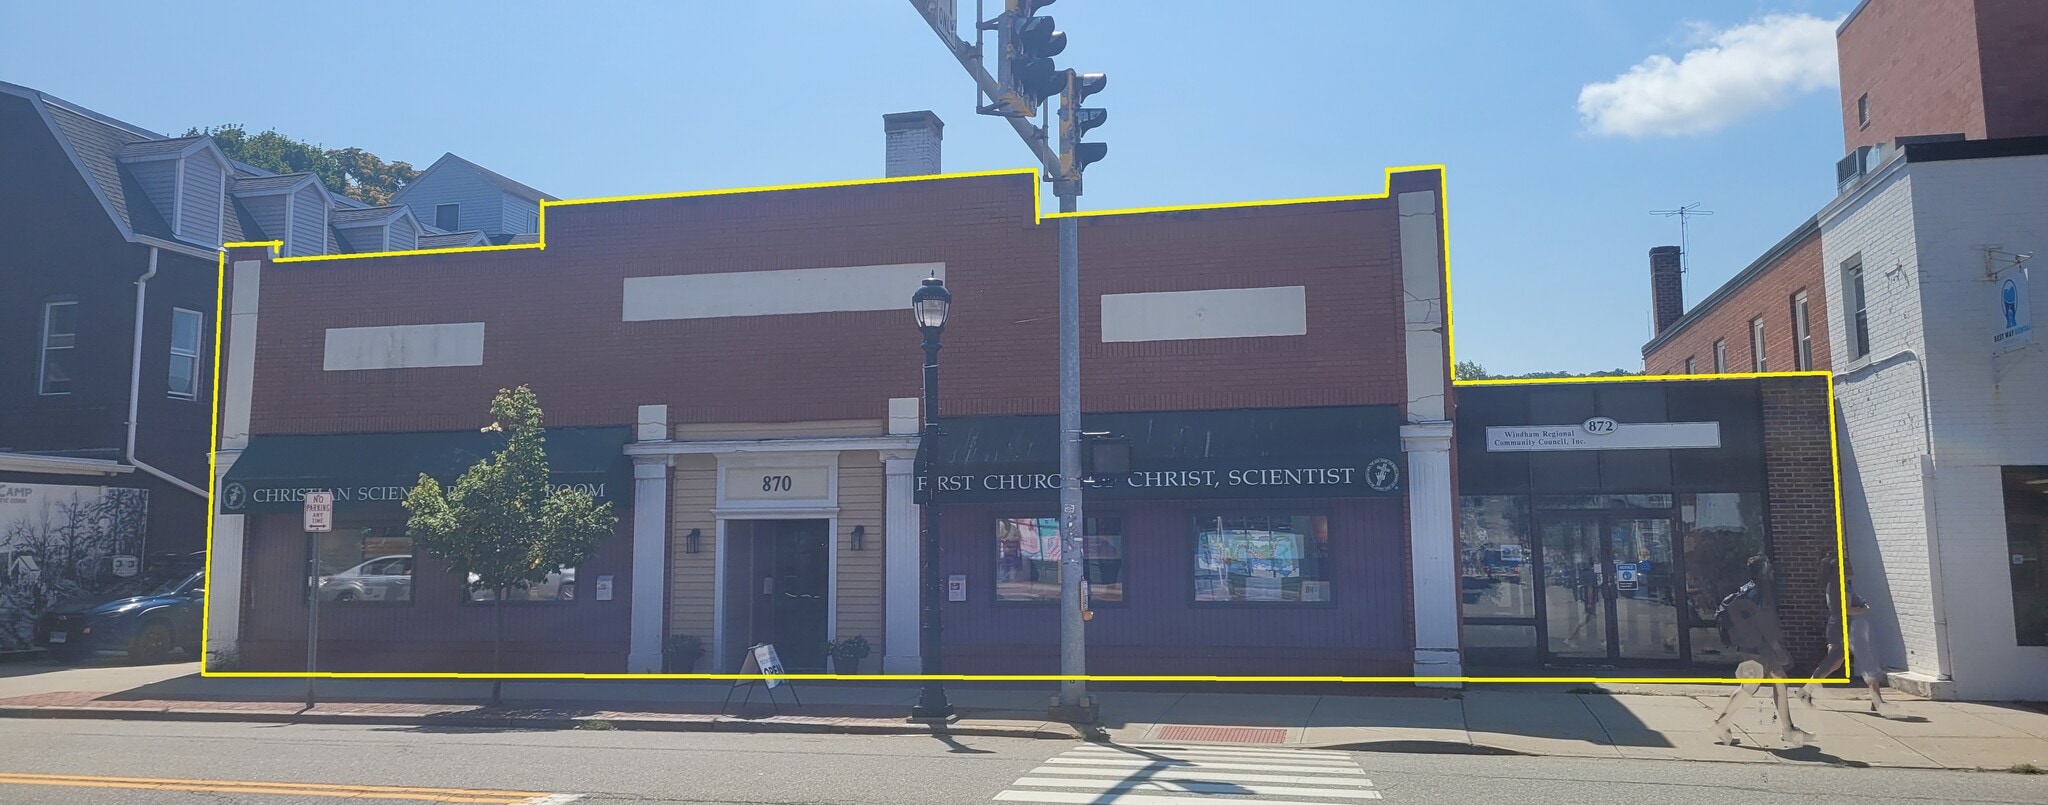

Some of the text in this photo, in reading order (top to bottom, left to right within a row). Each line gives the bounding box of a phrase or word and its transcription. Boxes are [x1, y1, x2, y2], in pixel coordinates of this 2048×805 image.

[1588, 420, 1613, 432] 872
[1543, 430, 1575, 439] Regional
[1494, 439, 1535, 447] Community
[762, 475, 792, 492] 870
[916, 475, 974, 492] FRST
[983, 473, 1062, 490] CHURC
[1228, 468, 1355, 486] SCIENTIST
[253, 487, 352, 503] CHRISAN
[305, 504, 330, 512] PARKING
